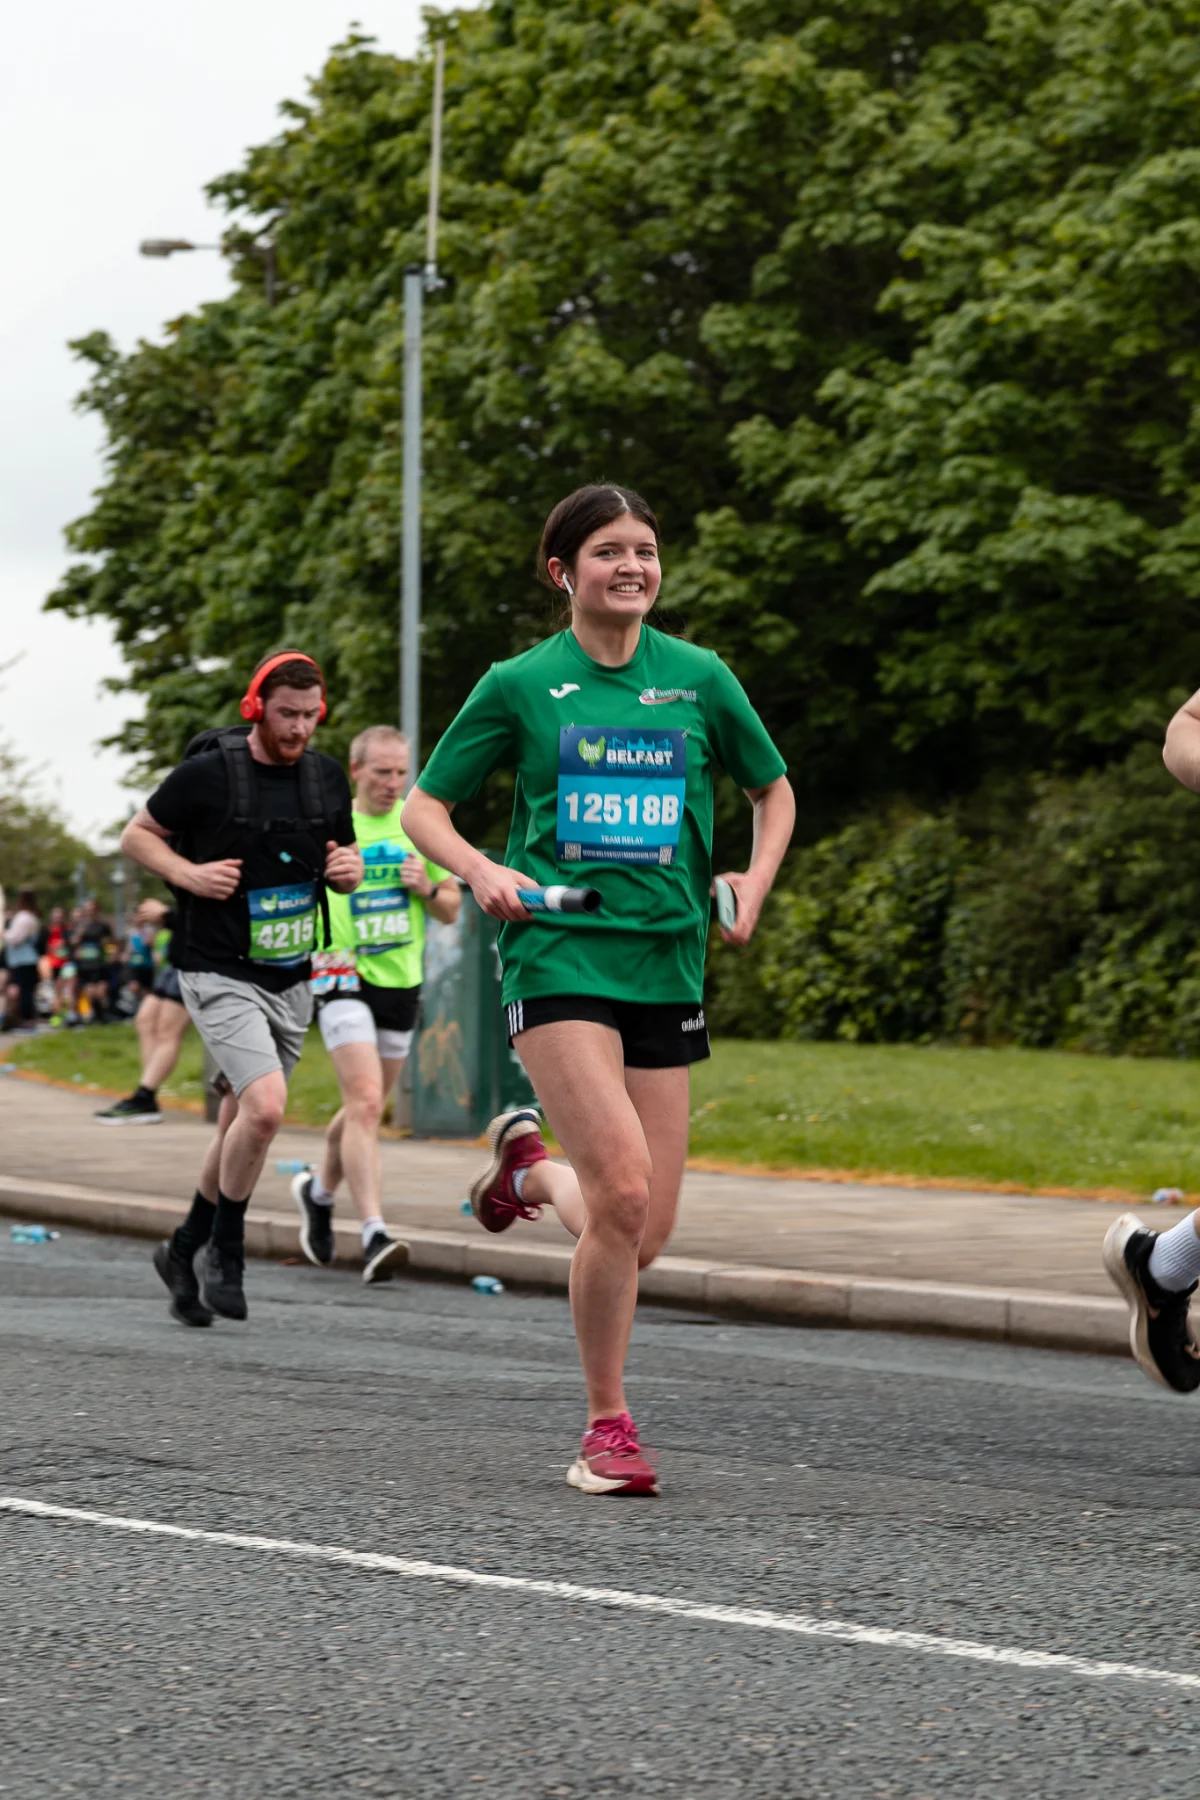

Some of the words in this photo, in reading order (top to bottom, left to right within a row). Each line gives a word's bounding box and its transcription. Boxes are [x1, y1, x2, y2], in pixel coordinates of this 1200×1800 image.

[606, 749, 673, 766] BELFAST
[565, 792, 679, 826] 12518B
[601, 835, 620, 845] TEAM
[621, 835, 644, 846] RELAY
[256, 915, 313, 949] 4215
[355, 913, 410, 939] 1746
